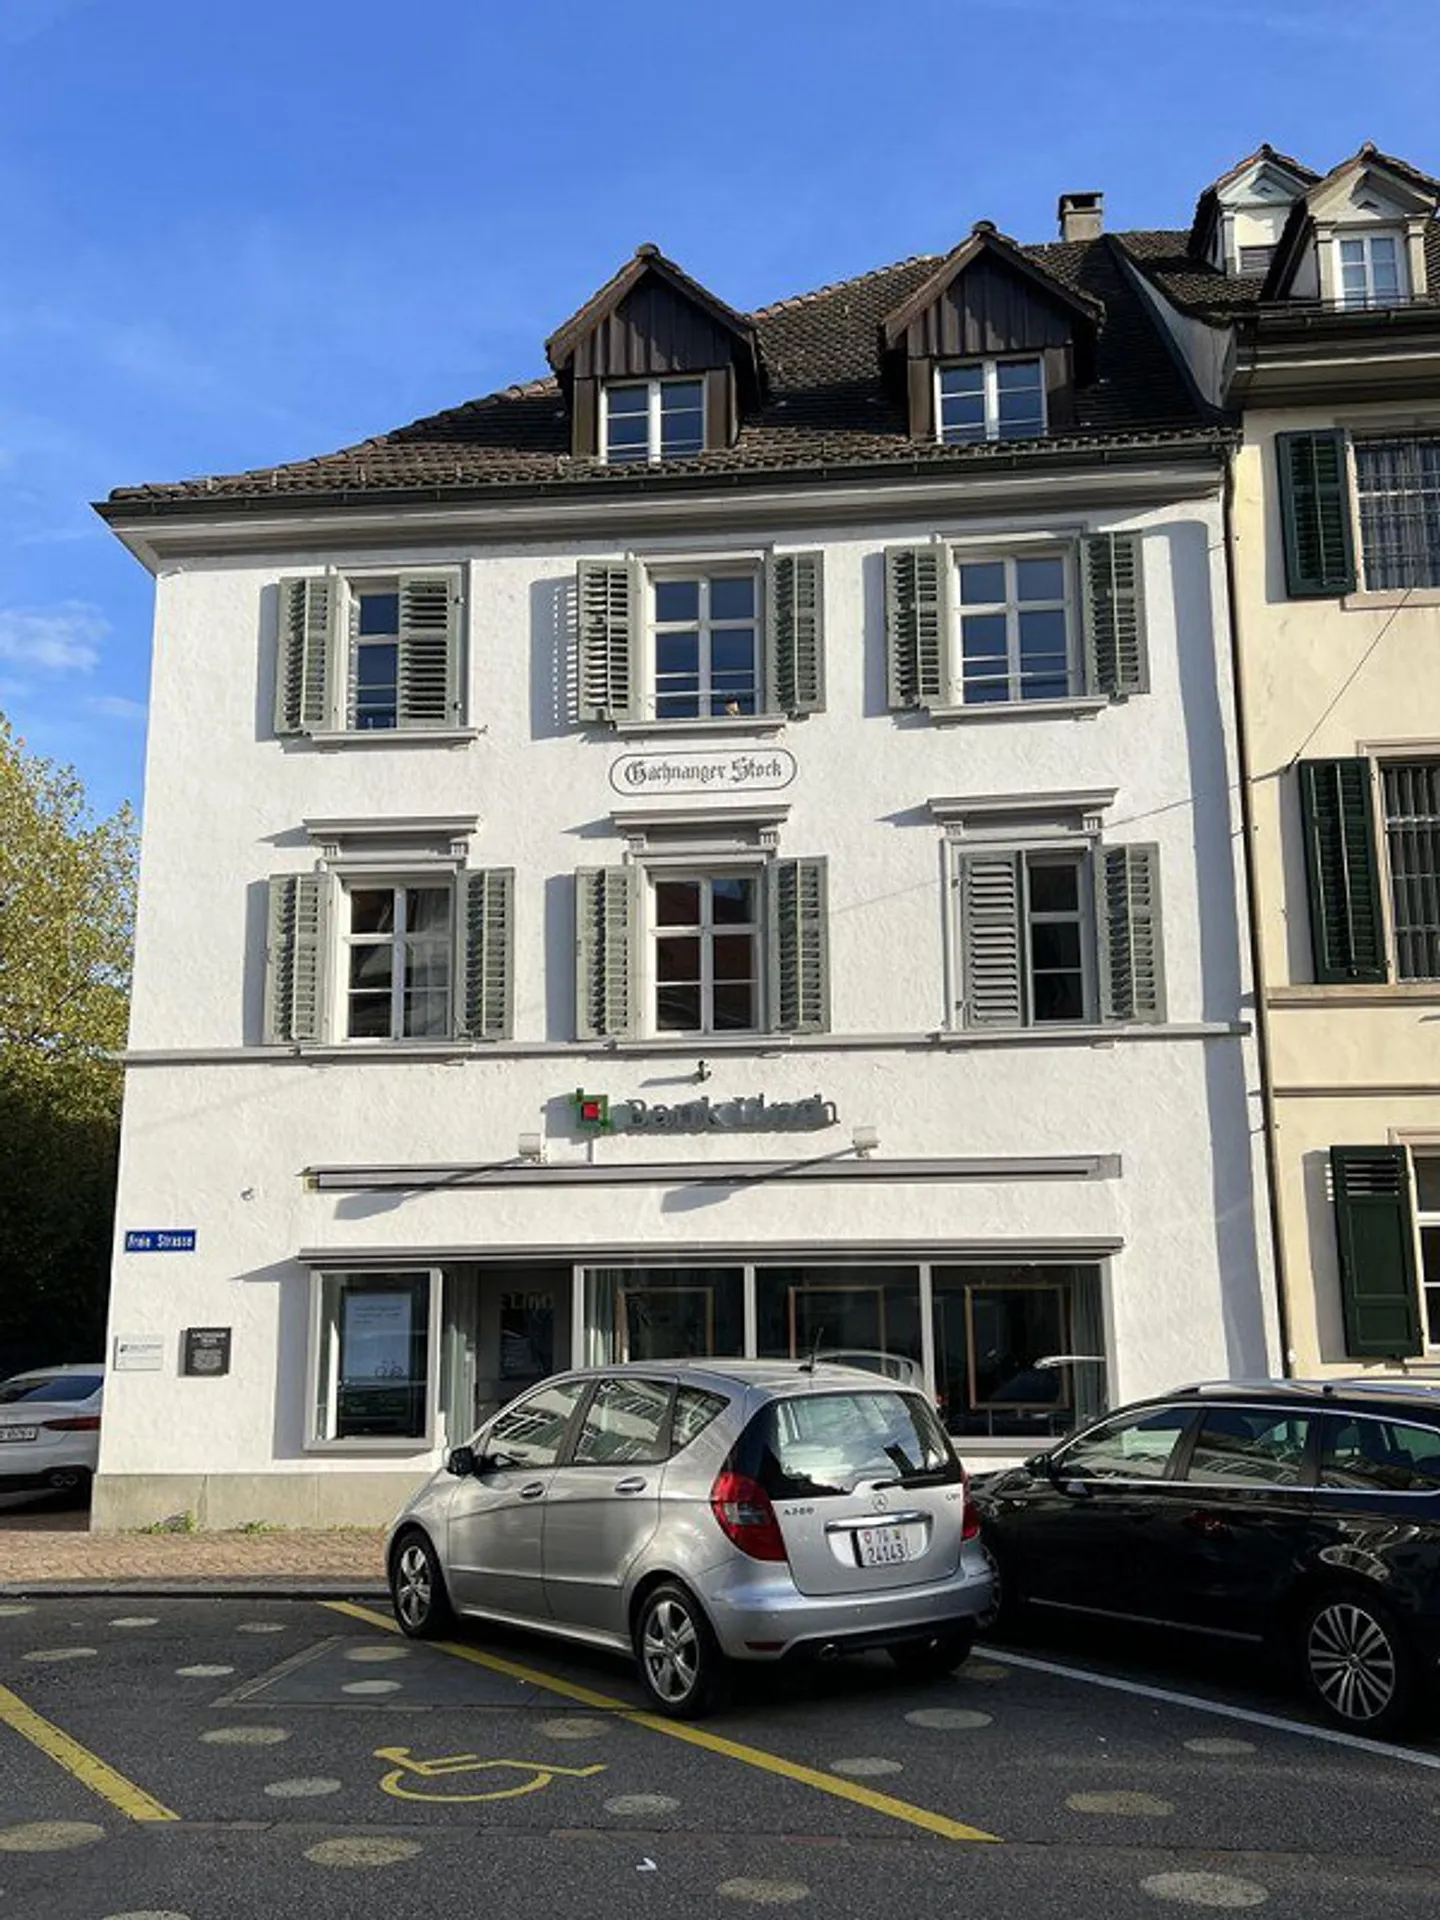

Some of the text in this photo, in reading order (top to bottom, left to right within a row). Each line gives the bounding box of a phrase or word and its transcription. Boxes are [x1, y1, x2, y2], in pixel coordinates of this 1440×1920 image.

[624, 756, 782, 785] Gachnanger Stock
[868, 1543, 905, 1564] 24143
